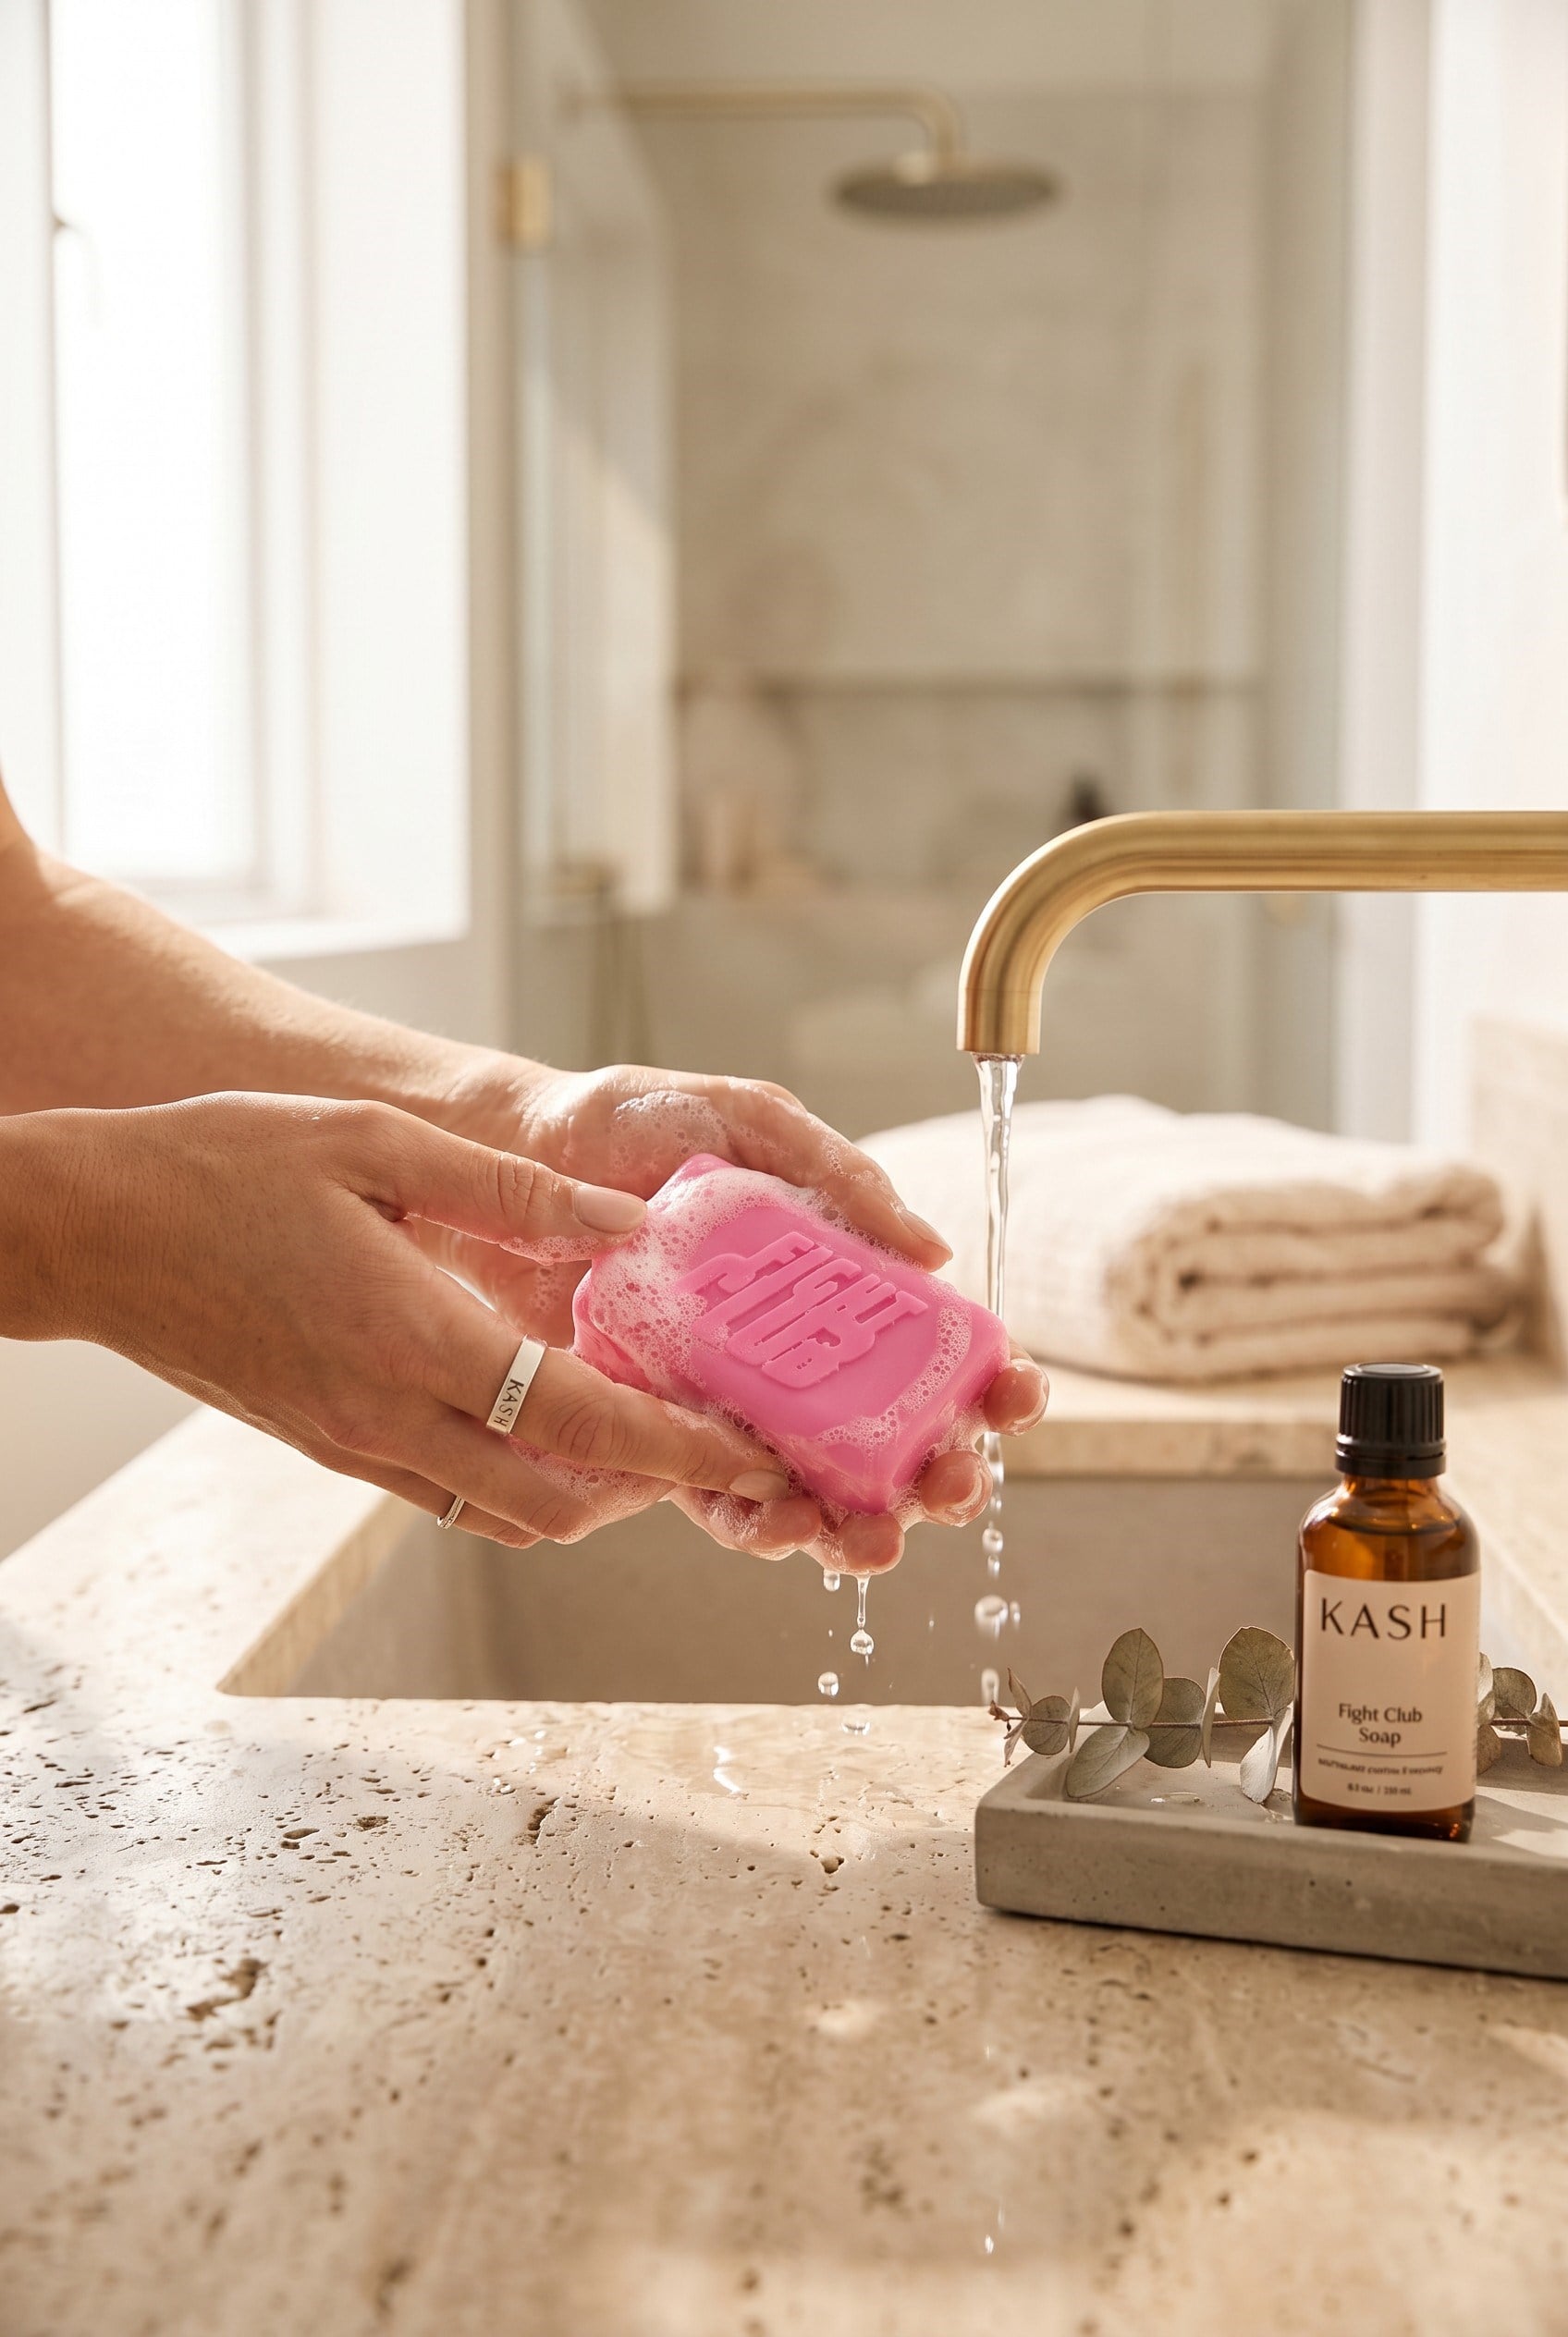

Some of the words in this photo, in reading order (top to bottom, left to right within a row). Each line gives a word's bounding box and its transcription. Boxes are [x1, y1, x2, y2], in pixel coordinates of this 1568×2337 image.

[494, 1378, 525, 1427] KASH
[1321, 1597, 1446, 1640] KASH
[1339, 1703, 1378, 1725] Fight
[1384, 1707, 1423, 1724] Club
[1359, 1728, 1402, 1748] Soap
